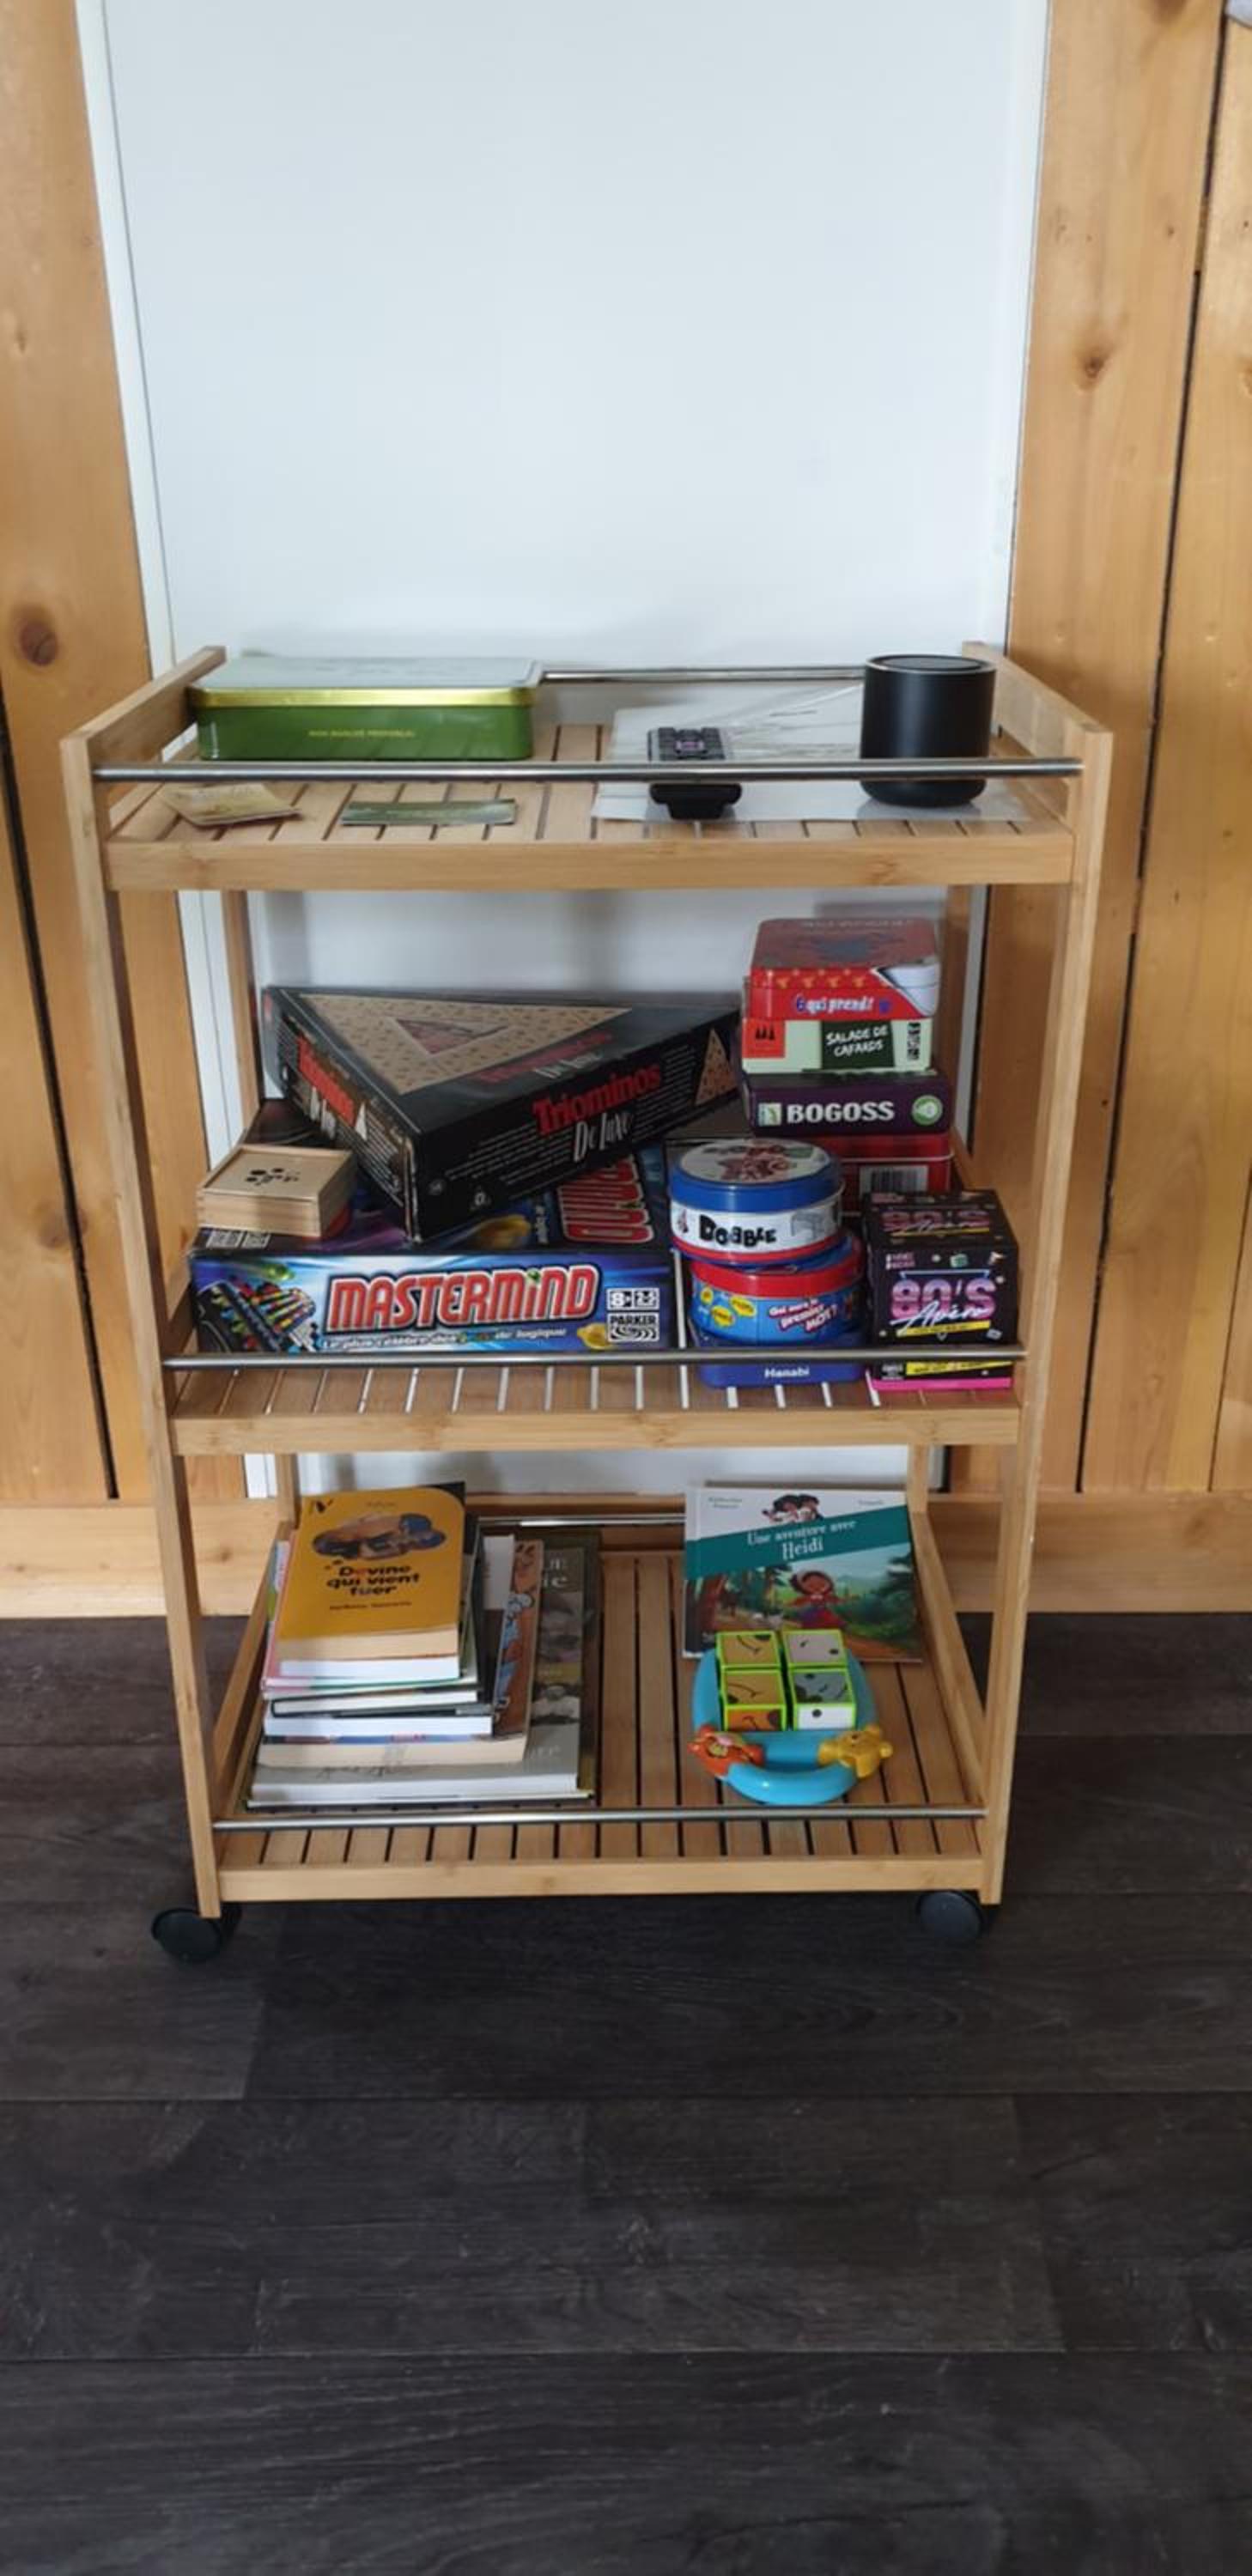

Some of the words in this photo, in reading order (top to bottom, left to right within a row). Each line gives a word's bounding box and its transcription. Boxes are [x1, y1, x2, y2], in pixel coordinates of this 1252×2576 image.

[825, 1028, 871, 1046] SALADE
[872, 1024, 889, 1038] DE
[833, 1039, 884, 1057] CAFARDS
[532, 1064, 660, 1136] Triominos
[787, 1101, 895, 1125] BOGOSS
[700, 1214, 777, 1248] DOBBLE
[891, 1278, 996, 1320] 80'S
[611, 1315, 656, 1325] PARKER
[764, 1366, 810, 1378] Hanabi
[782, 1536, 824, 1561] Heidi
[327, 1578, 361, 1589] qui
[368, 1573, 419, 1586] vient
[339, 1566, 411, 1577] Devine
[350, 1585, 398, 1596] tuer
